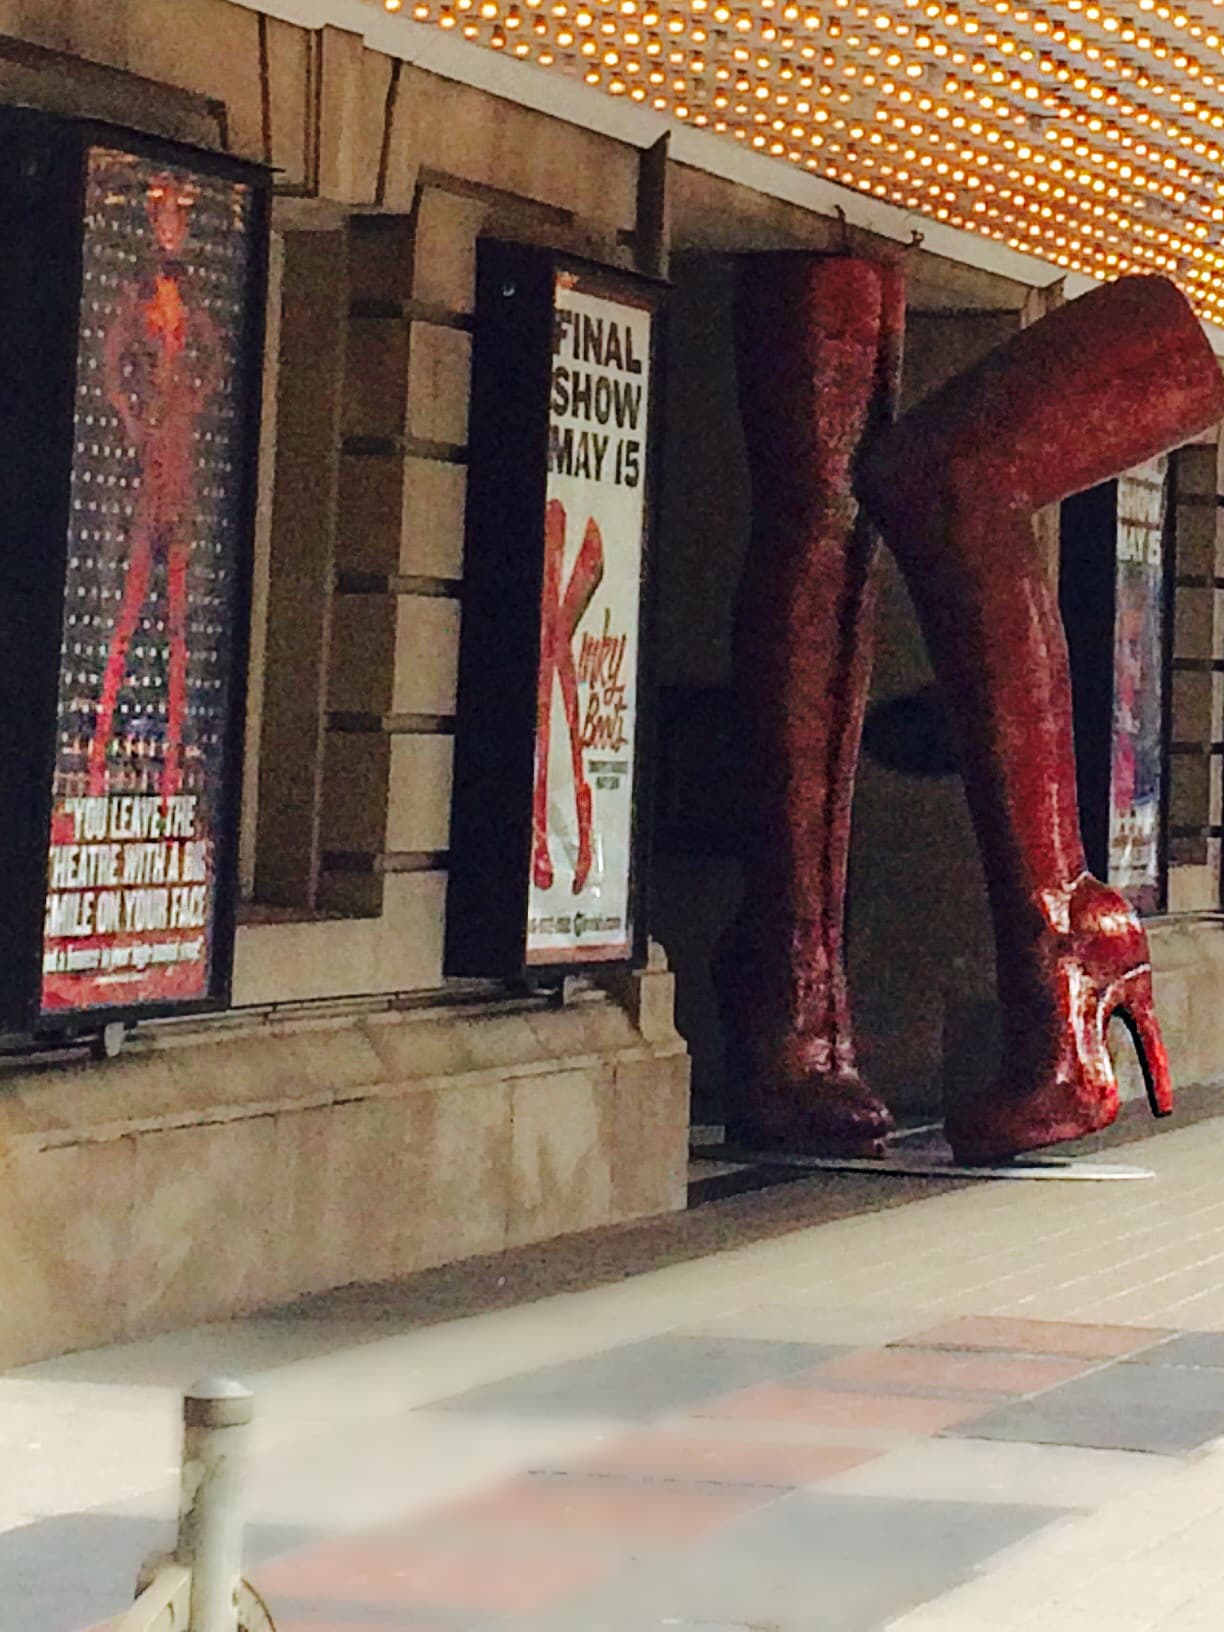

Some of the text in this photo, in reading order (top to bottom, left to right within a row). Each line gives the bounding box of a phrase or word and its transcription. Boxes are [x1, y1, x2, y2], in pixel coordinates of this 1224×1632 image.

[551, 309, 643, 375] FINAL
[550, 366, 642, 431] SHOW
[547, 424, 640, 488] MAY 15
[532, 499, 627, 895] Kinky
[579, 694, 629, 753] Boots
[109, 796, 162, 839] LEAVE
[164, 794, 197, 838] THE
[122, 841, 165, 886] WITH
[166, 840, 180, 884] A
[96, 889, 122, 934] ON
[124, 887, 168, 932] YOUR
